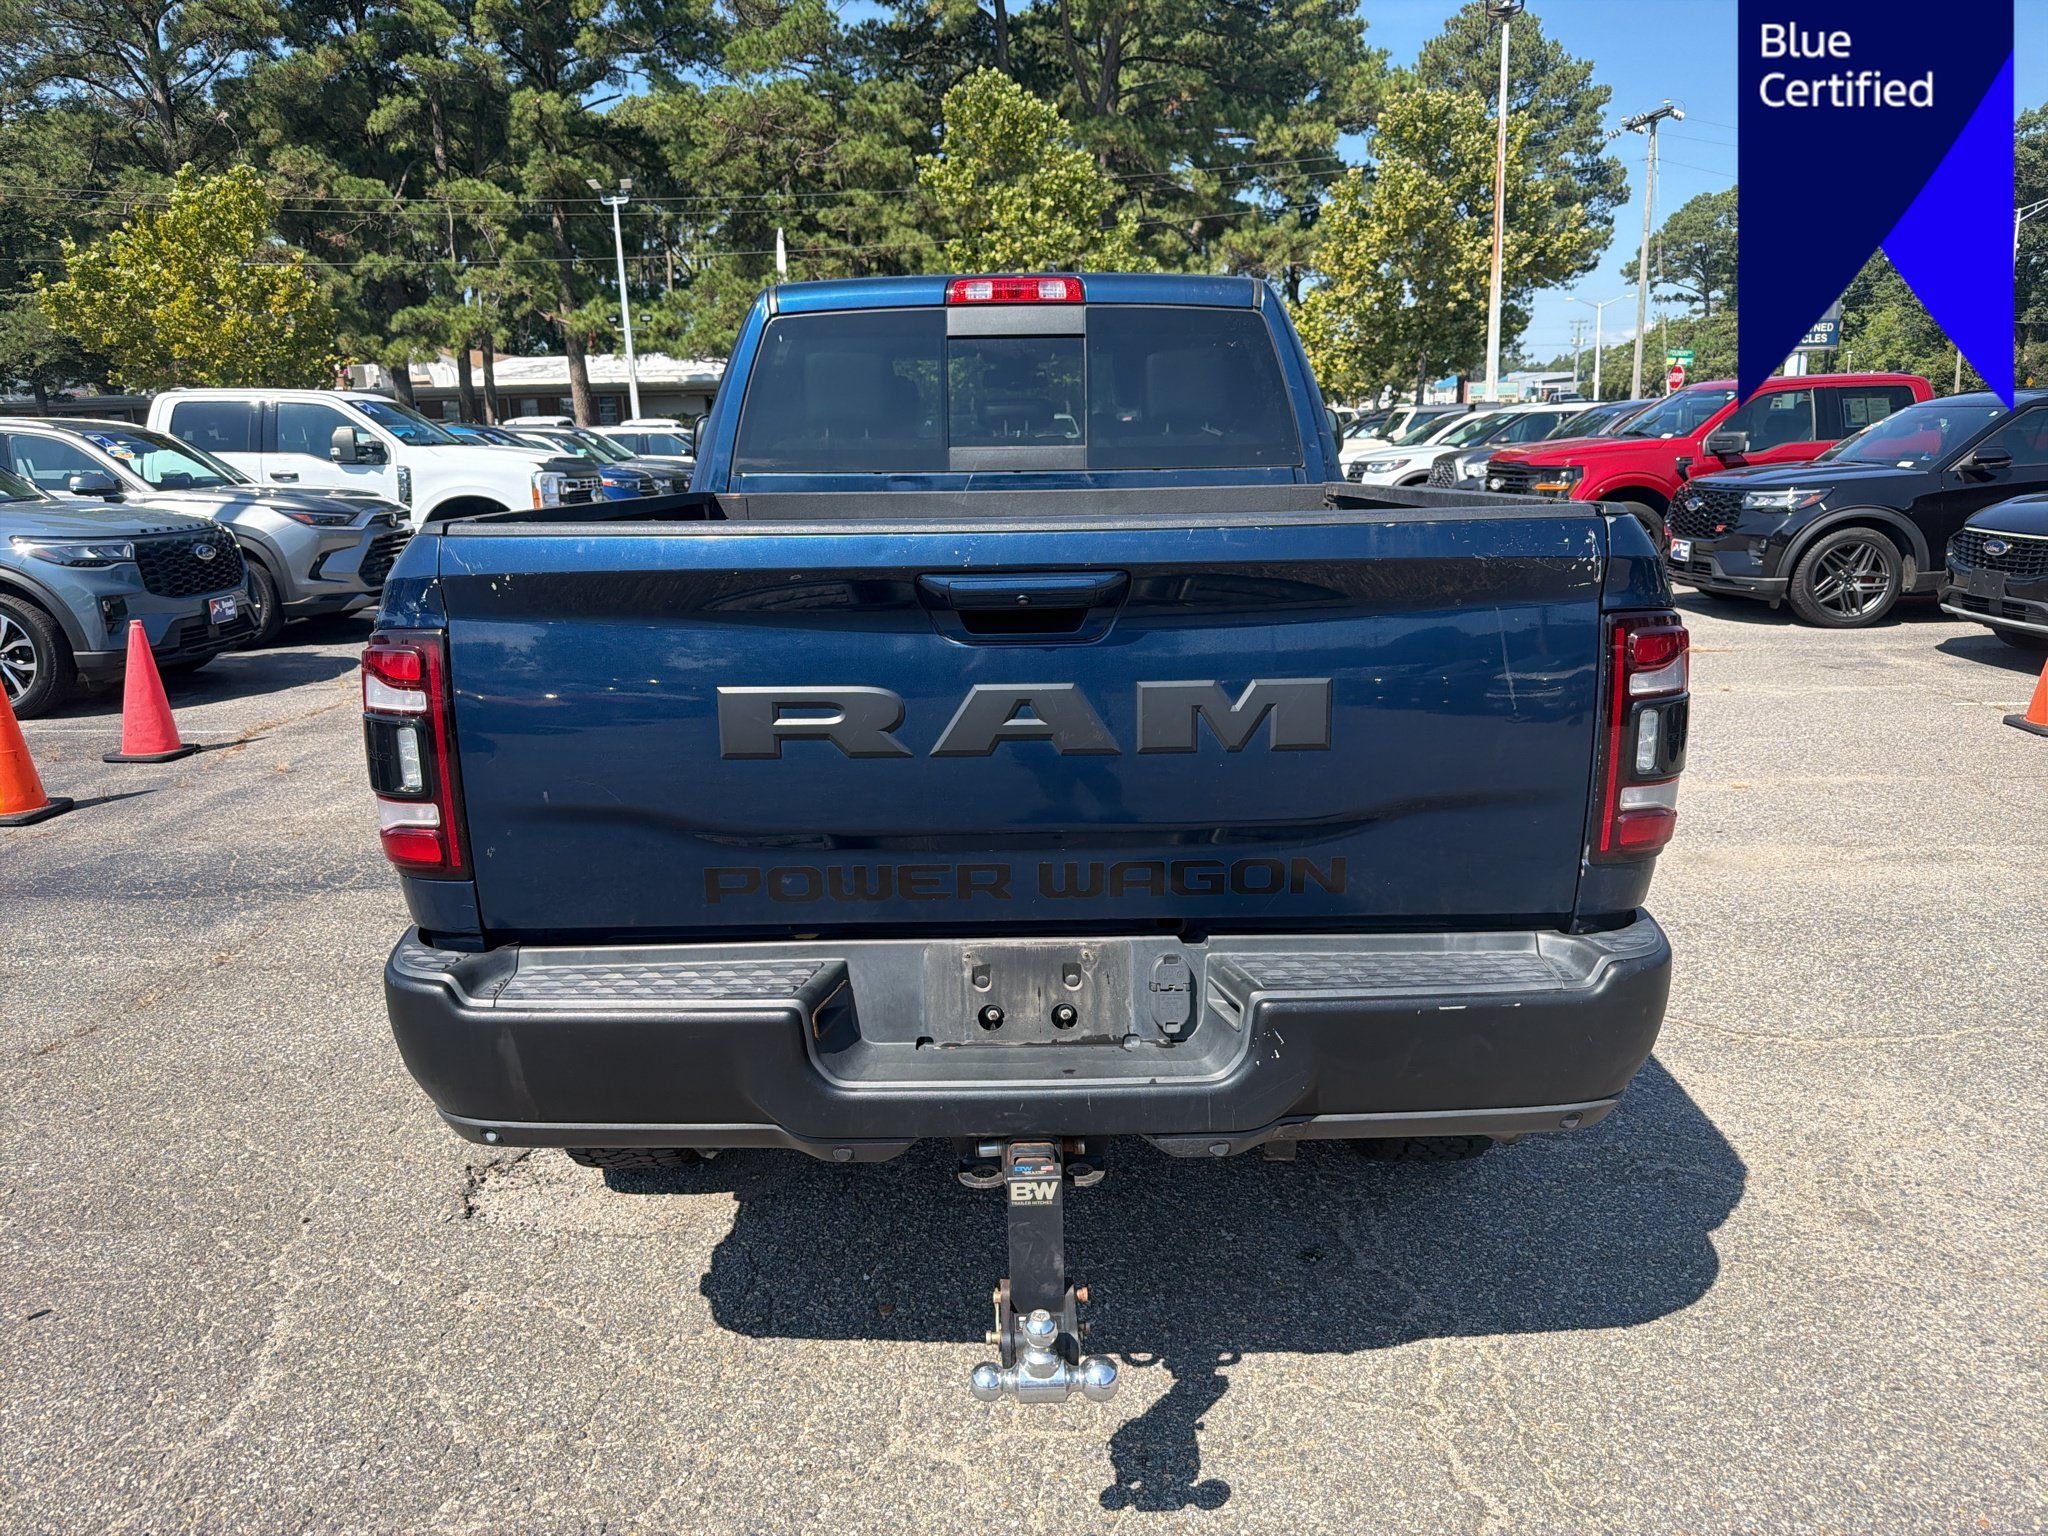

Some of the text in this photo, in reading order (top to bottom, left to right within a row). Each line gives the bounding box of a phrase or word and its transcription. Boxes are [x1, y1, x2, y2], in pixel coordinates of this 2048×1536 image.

[1809, 322, 1834, 332] NED
[1669, 372, 1683, 383] STOP
[716, 677, 1333, 759] RAM
[703, 856, 1347, 904] POWER WAGON
